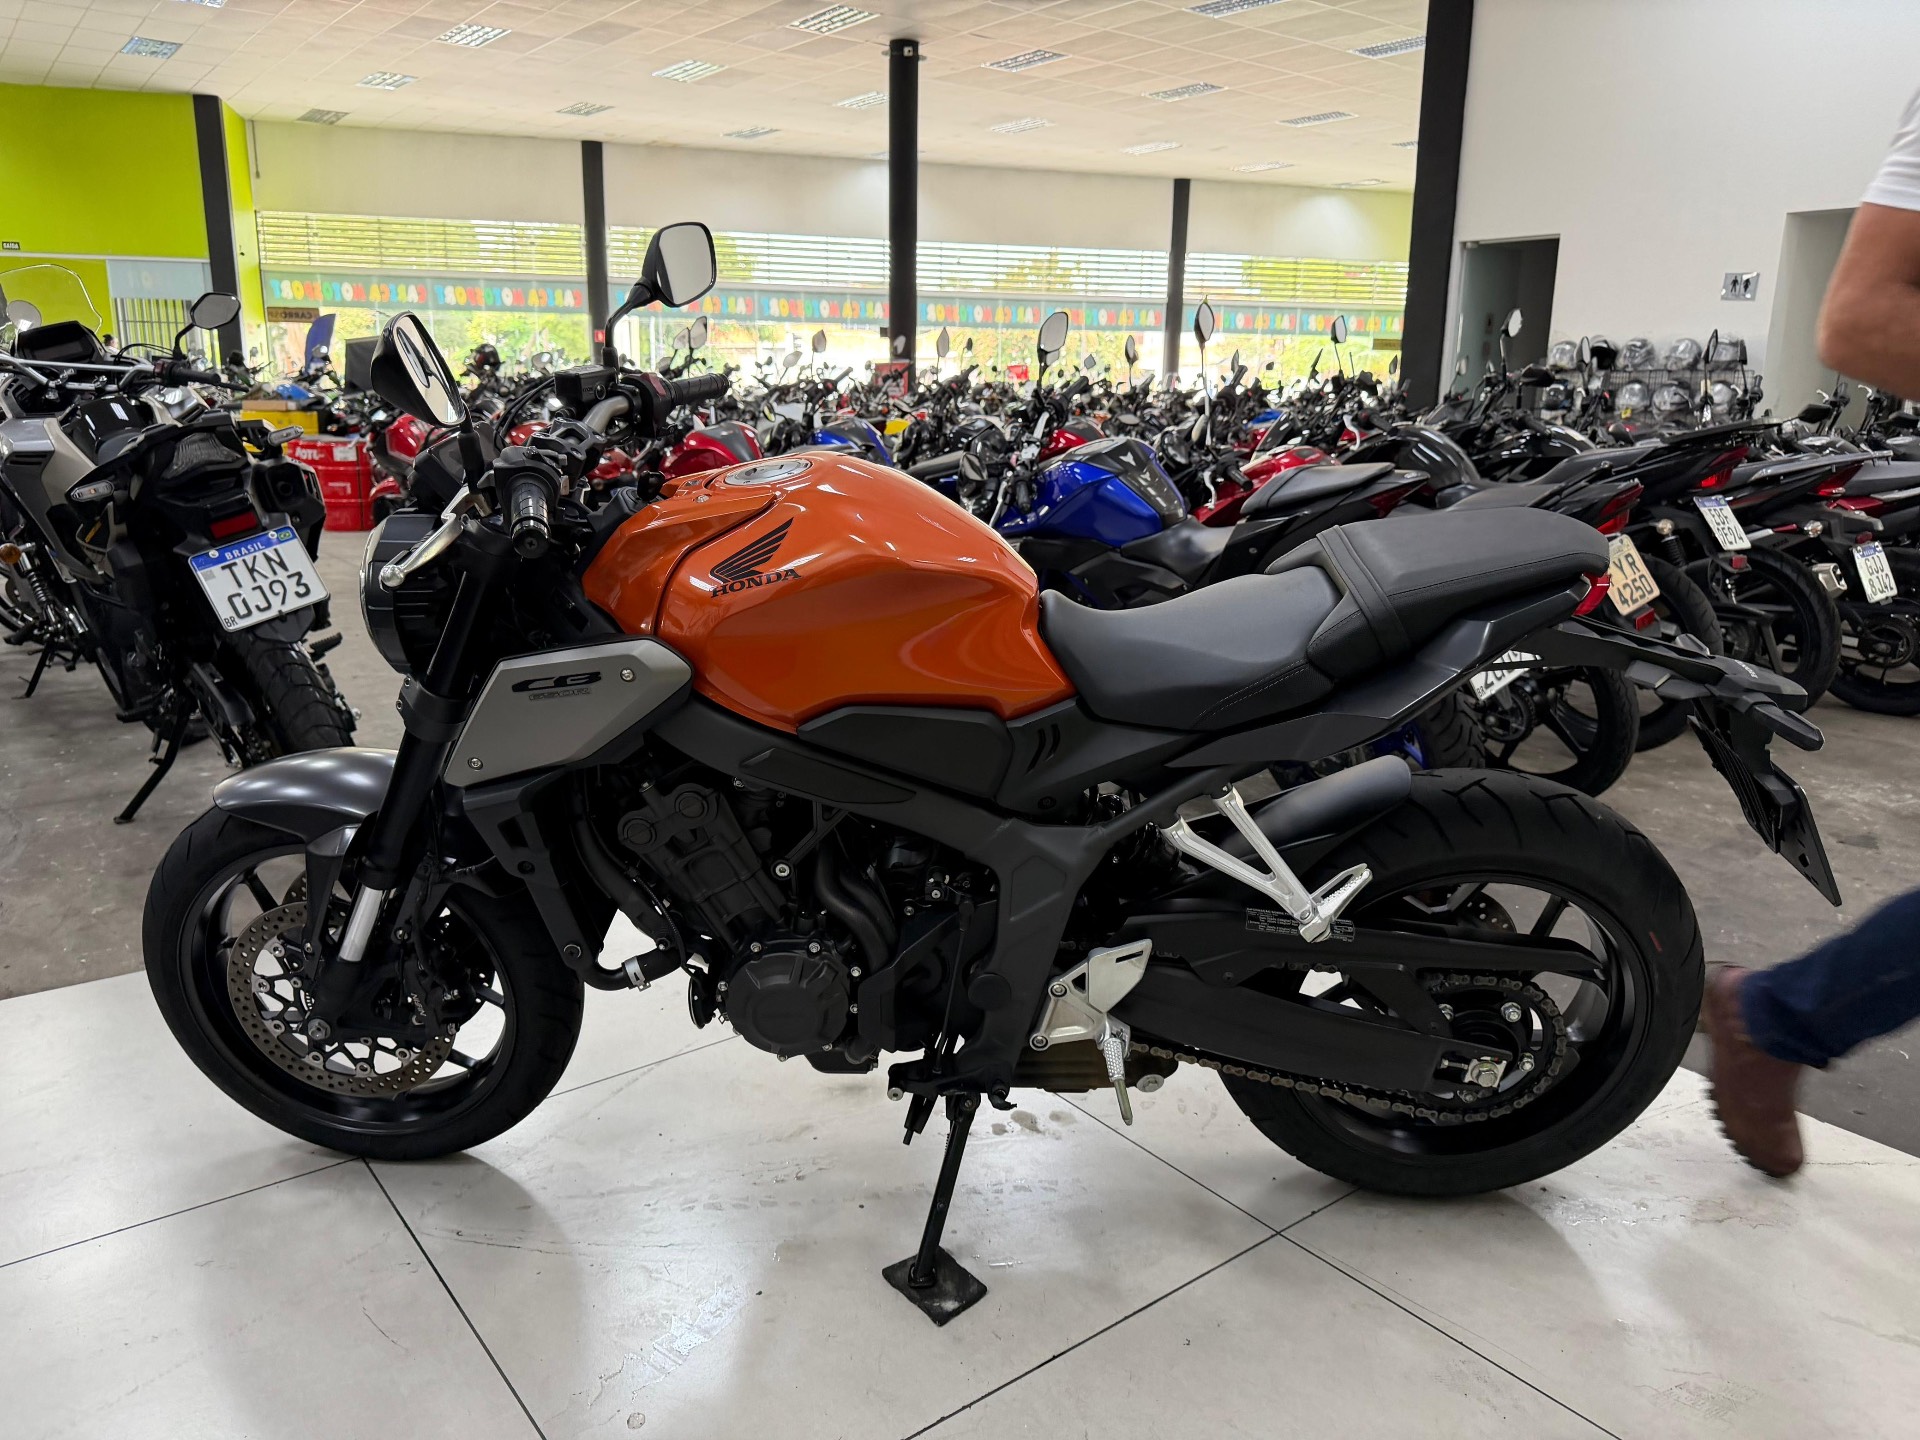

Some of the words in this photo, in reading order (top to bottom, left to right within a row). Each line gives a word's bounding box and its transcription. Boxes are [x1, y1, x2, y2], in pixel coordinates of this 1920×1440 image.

[225, 542, 265, 560] BRASIL
[221, 548, 289, 588] TKN
[711, 568, 801, 598] HONDA
[1617, 573, 1654, 607] 4250
[224, 616, 238, 627] BR
[512, 671, 602, 692] CB
